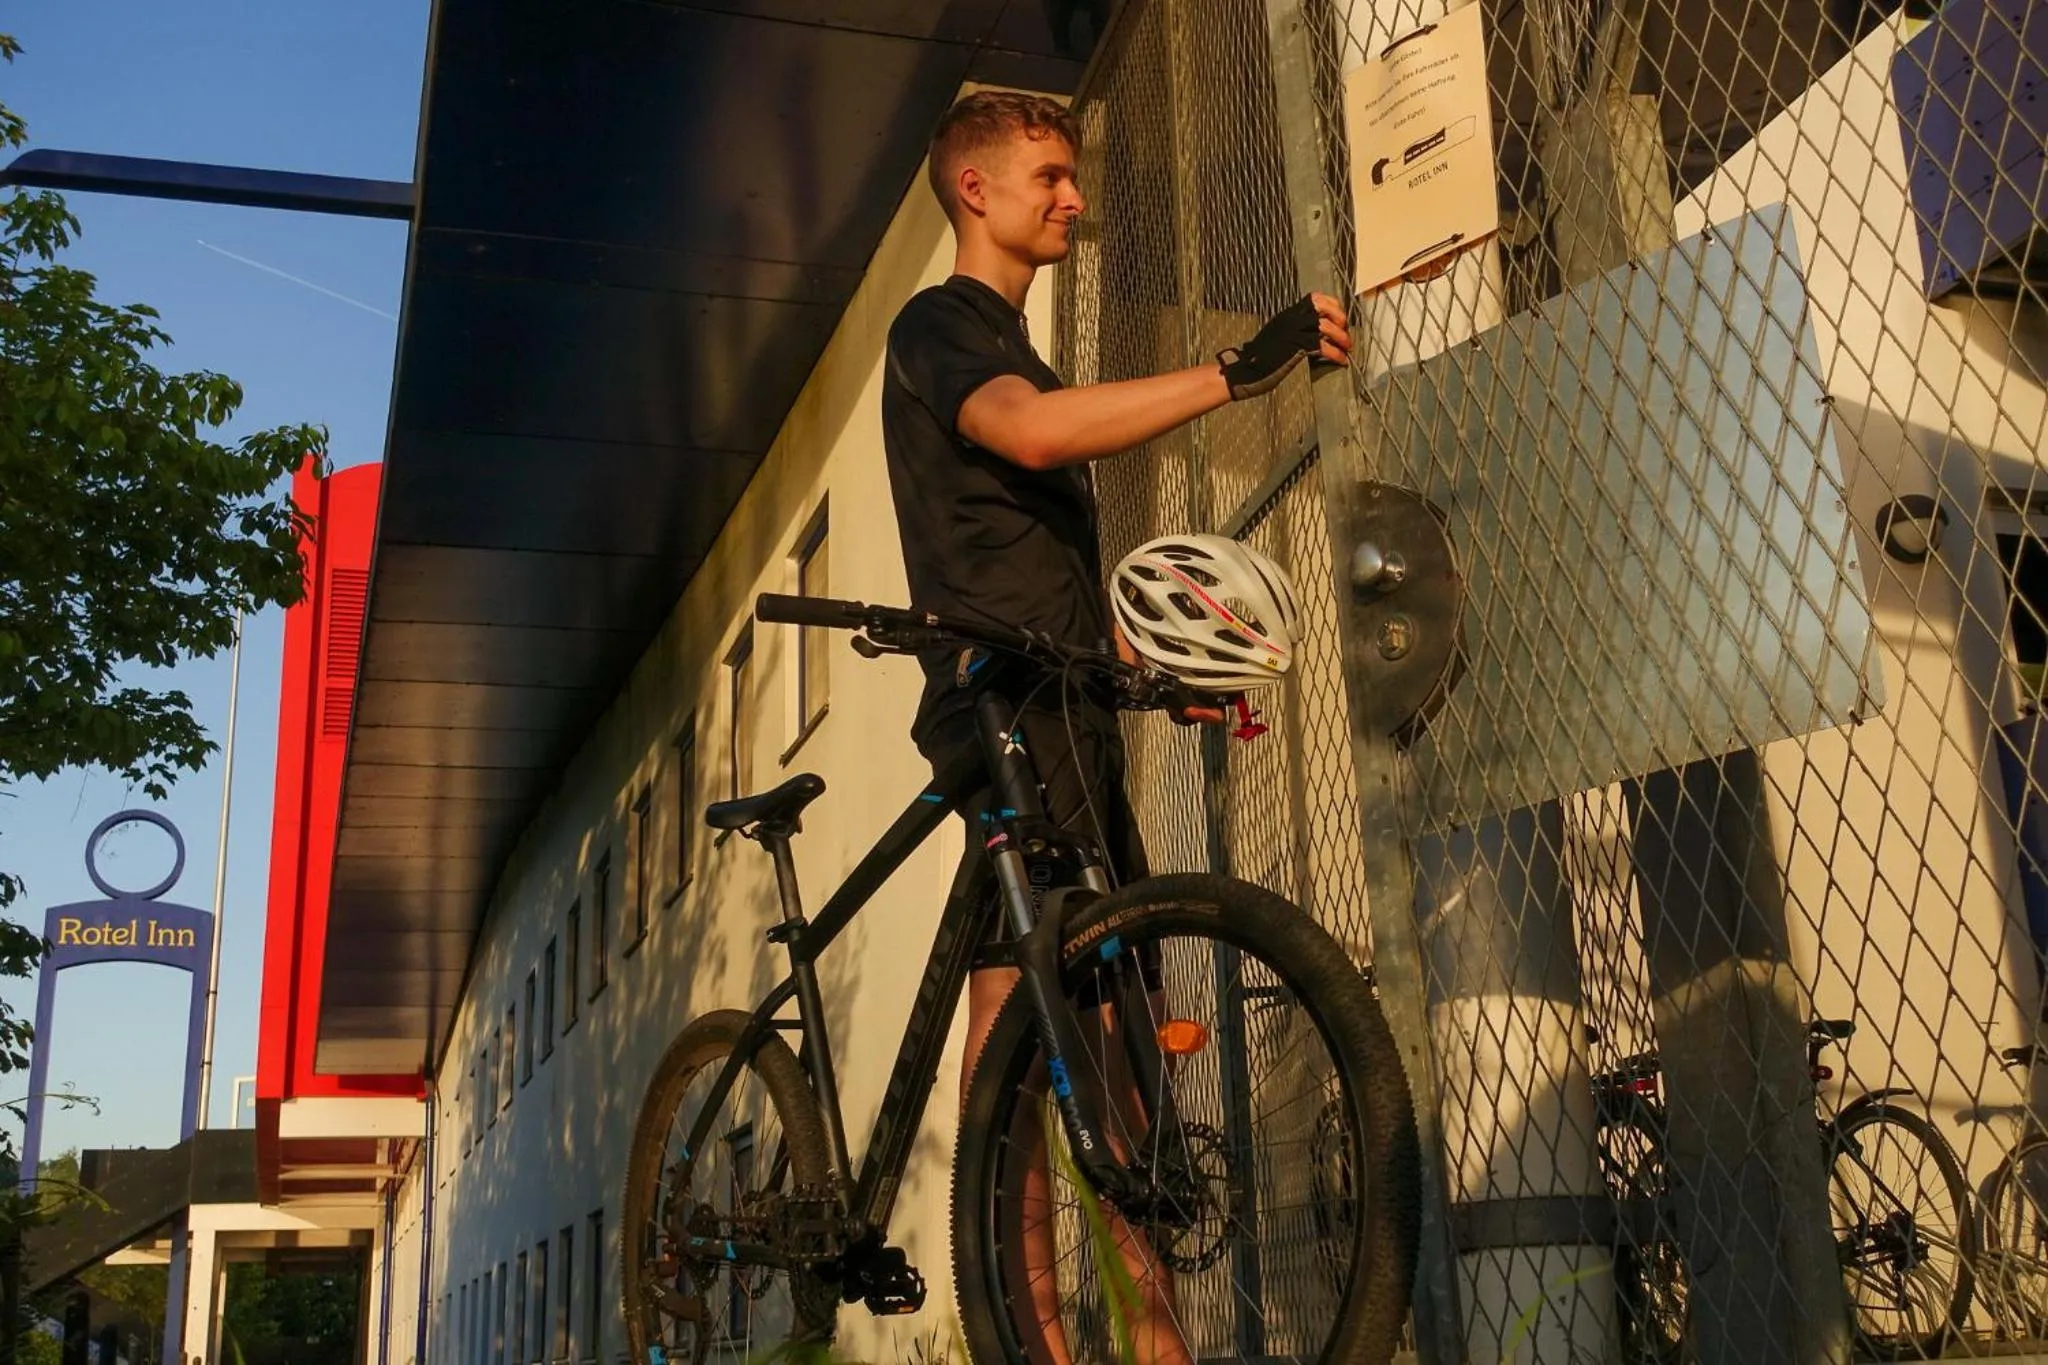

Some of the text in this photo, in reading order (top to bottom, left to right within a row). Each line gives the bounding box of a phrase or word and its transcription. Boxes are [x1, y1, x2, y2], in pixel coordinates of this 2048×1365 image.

[1408, 161, 1449, 190] ROTEL INN
[58, 917, 196, 947] Rotel Inn
[1079, 1129, 1093, 1151] EVO
